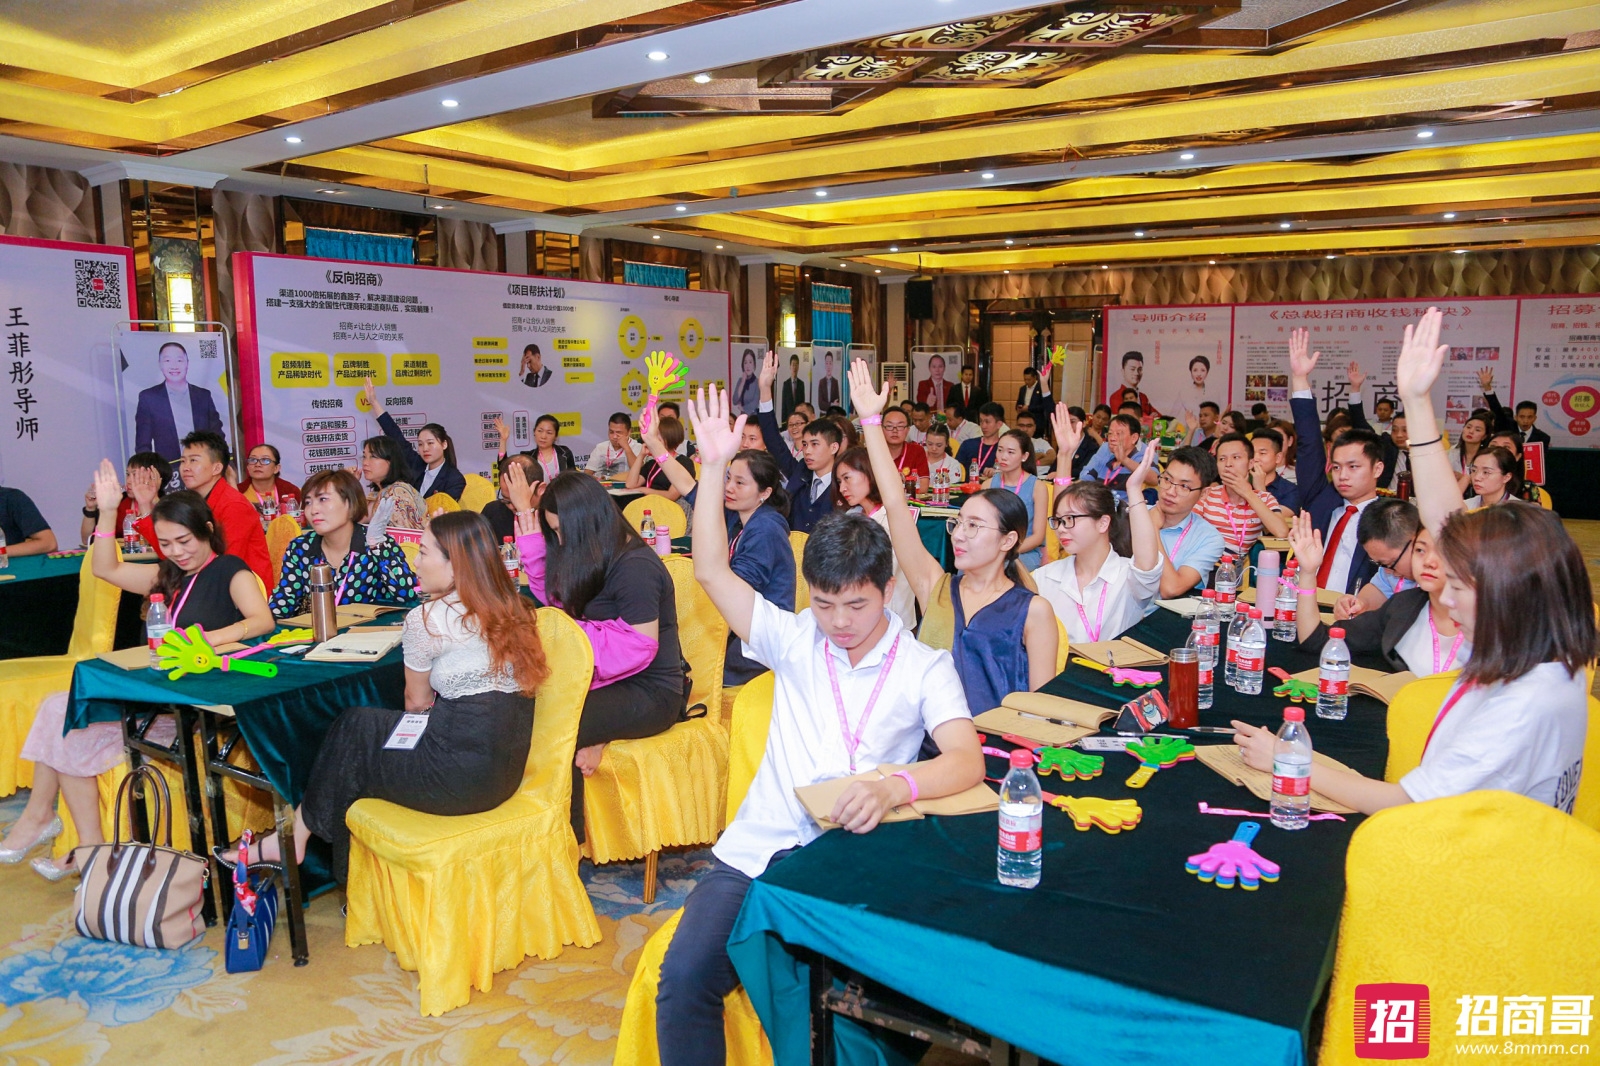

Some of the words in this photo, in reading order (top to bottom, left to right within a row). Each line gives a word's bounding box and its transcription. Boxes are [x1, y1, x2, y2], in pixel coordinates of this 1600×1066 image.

[325, 270, 383, 286] 《反向招商》
[507, 284, 565, 298] 《项目帮扶计划》
[1548, 304, 1600, 316] 招募
[1132, 313, 1206, 322] 导师介绍
[342, 361, 369, 369] 品牌制胜
[5, 307, 39, 441] 王菲彤导师
[311, 399, 343, 409] 传统招商
[385, 396, 414, 406] 反向招商
[306, 420, 348, 430] 卖产品和服务
[306, 432, 349, 443] 花钱开店卖货
[308, 446, 351, 457] 花钱招聘员工
